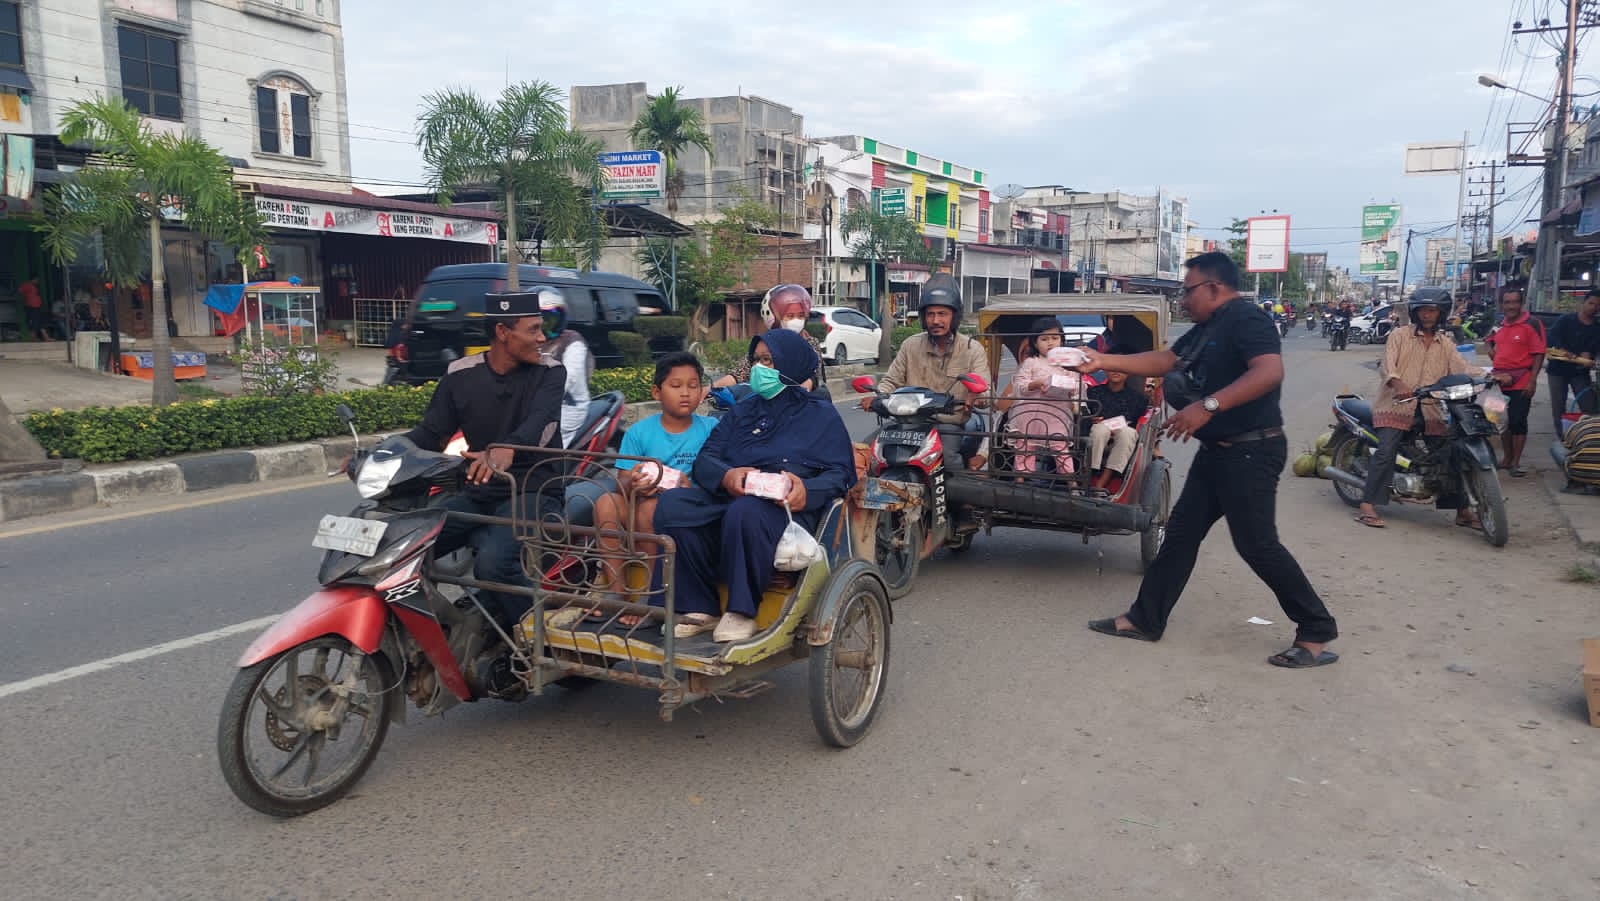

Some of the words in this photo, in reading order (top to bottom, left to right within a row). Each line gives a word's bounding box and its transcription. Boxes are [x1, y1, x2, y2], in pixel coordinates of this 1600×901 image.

[621, 153, 652, 161] MARKET
[635, 165, 657, 177] MART
[257, 200, 285, 213] KARENA
[291, 204, 311, 216] PASTI
[277, 214, 309, 227] PERTAMA
[392, 214, 414, 225] KARENA
[393, 224, 408, 234] YANG
[408, 225, 433, 236] PERTAMA
[935, 474, 946, 525] HONDA
